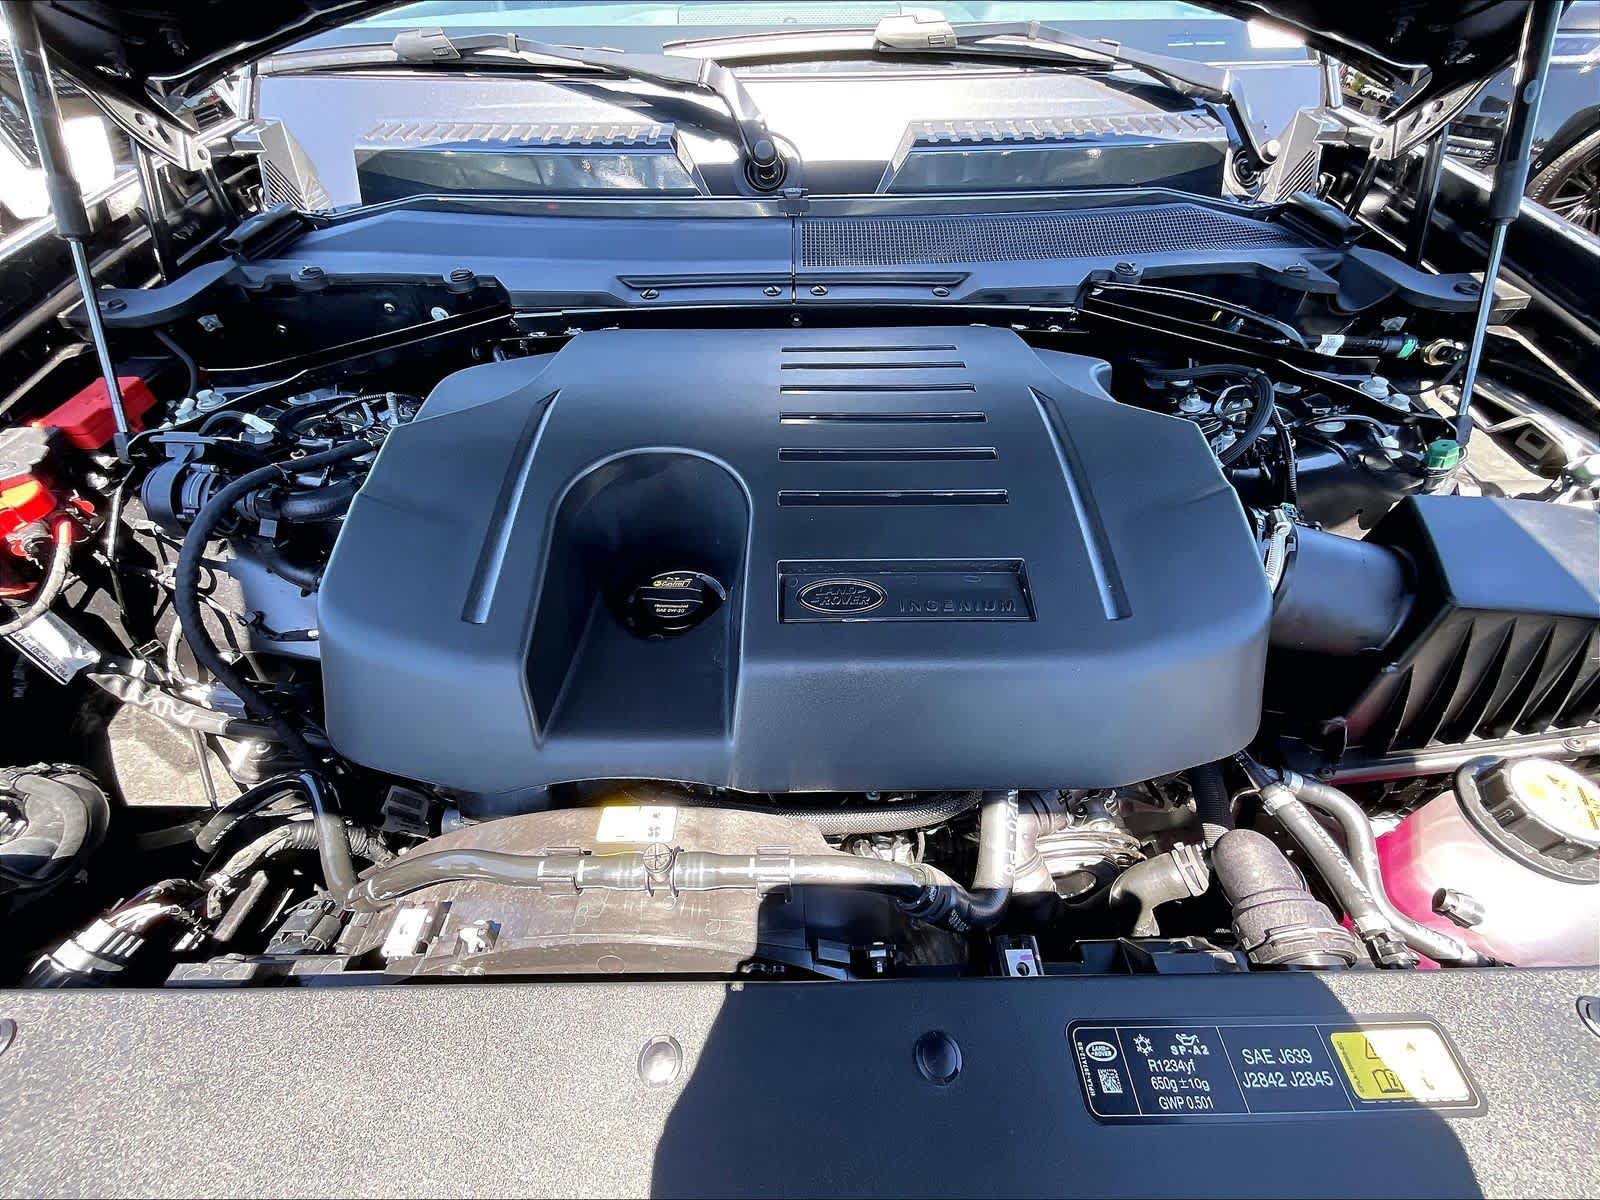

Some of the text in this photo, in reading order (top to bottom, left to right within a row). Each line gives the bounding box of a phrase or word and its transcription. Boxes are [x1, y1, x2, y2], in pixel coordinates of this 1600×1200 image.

[819, 596, 871, 606] ROVER
[899, 599, 1017, 612] INGENIUM
[1169, 1044, 1210, 1056] SP-A2
[1242, 1048, 1313, 1065] SAE J639
[1147, 1058, 1196, 1075] R1234yf
[1150, 1076, 1179, 1093] 650g
[1242, 1070, 1334, 1088] J2842 J2845
[1158, 1095, 1214, 1110] GWP 0.501
